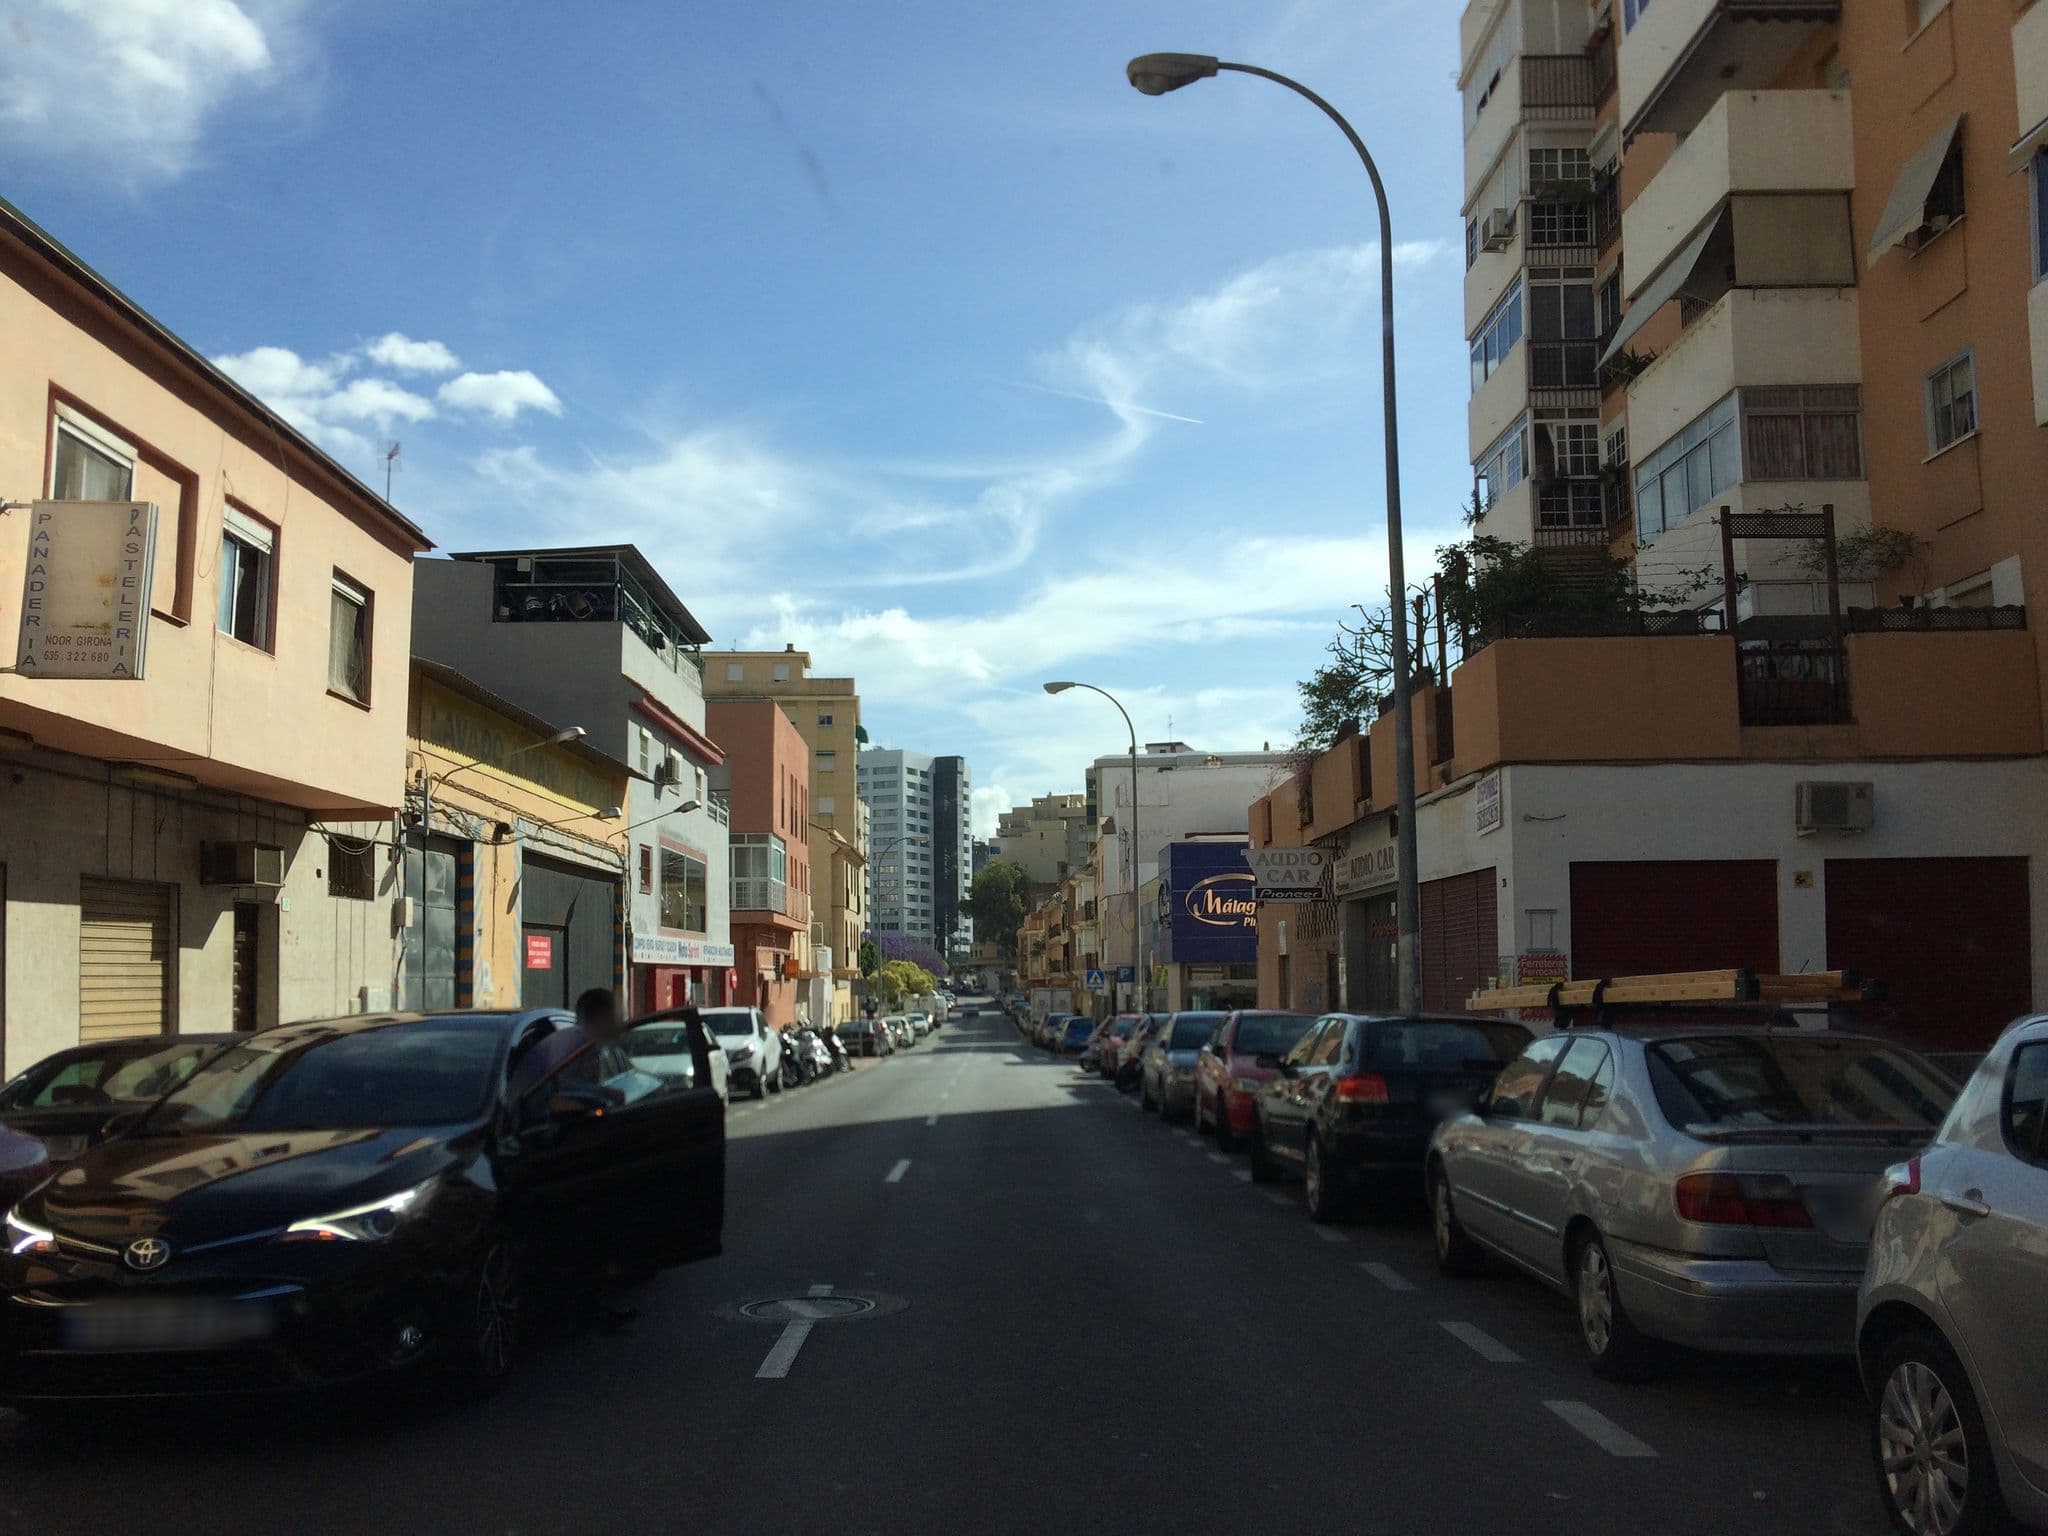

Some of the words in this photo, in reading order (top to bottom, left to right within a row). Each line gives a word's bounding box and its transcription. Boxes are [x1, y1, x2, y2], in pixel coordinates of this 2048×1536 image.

[22, 513, 52, 667] PANADERIA
[112, 509, 141, 674] PASTELERIA
[45, 634, 72, 646] NOOR
[76, 636, 112, 647] GIRONA
[1256, 852, 1323, 866] AUDIO
[1350, 852, 1374, 880] AUDIO
[1377, 846, 1396, 871] CAR
[1266, 869, 1312, 883] CAR
[1193, 888, 1257, 916] Málag
[1260, 888, 1319, 898] Pioneer
